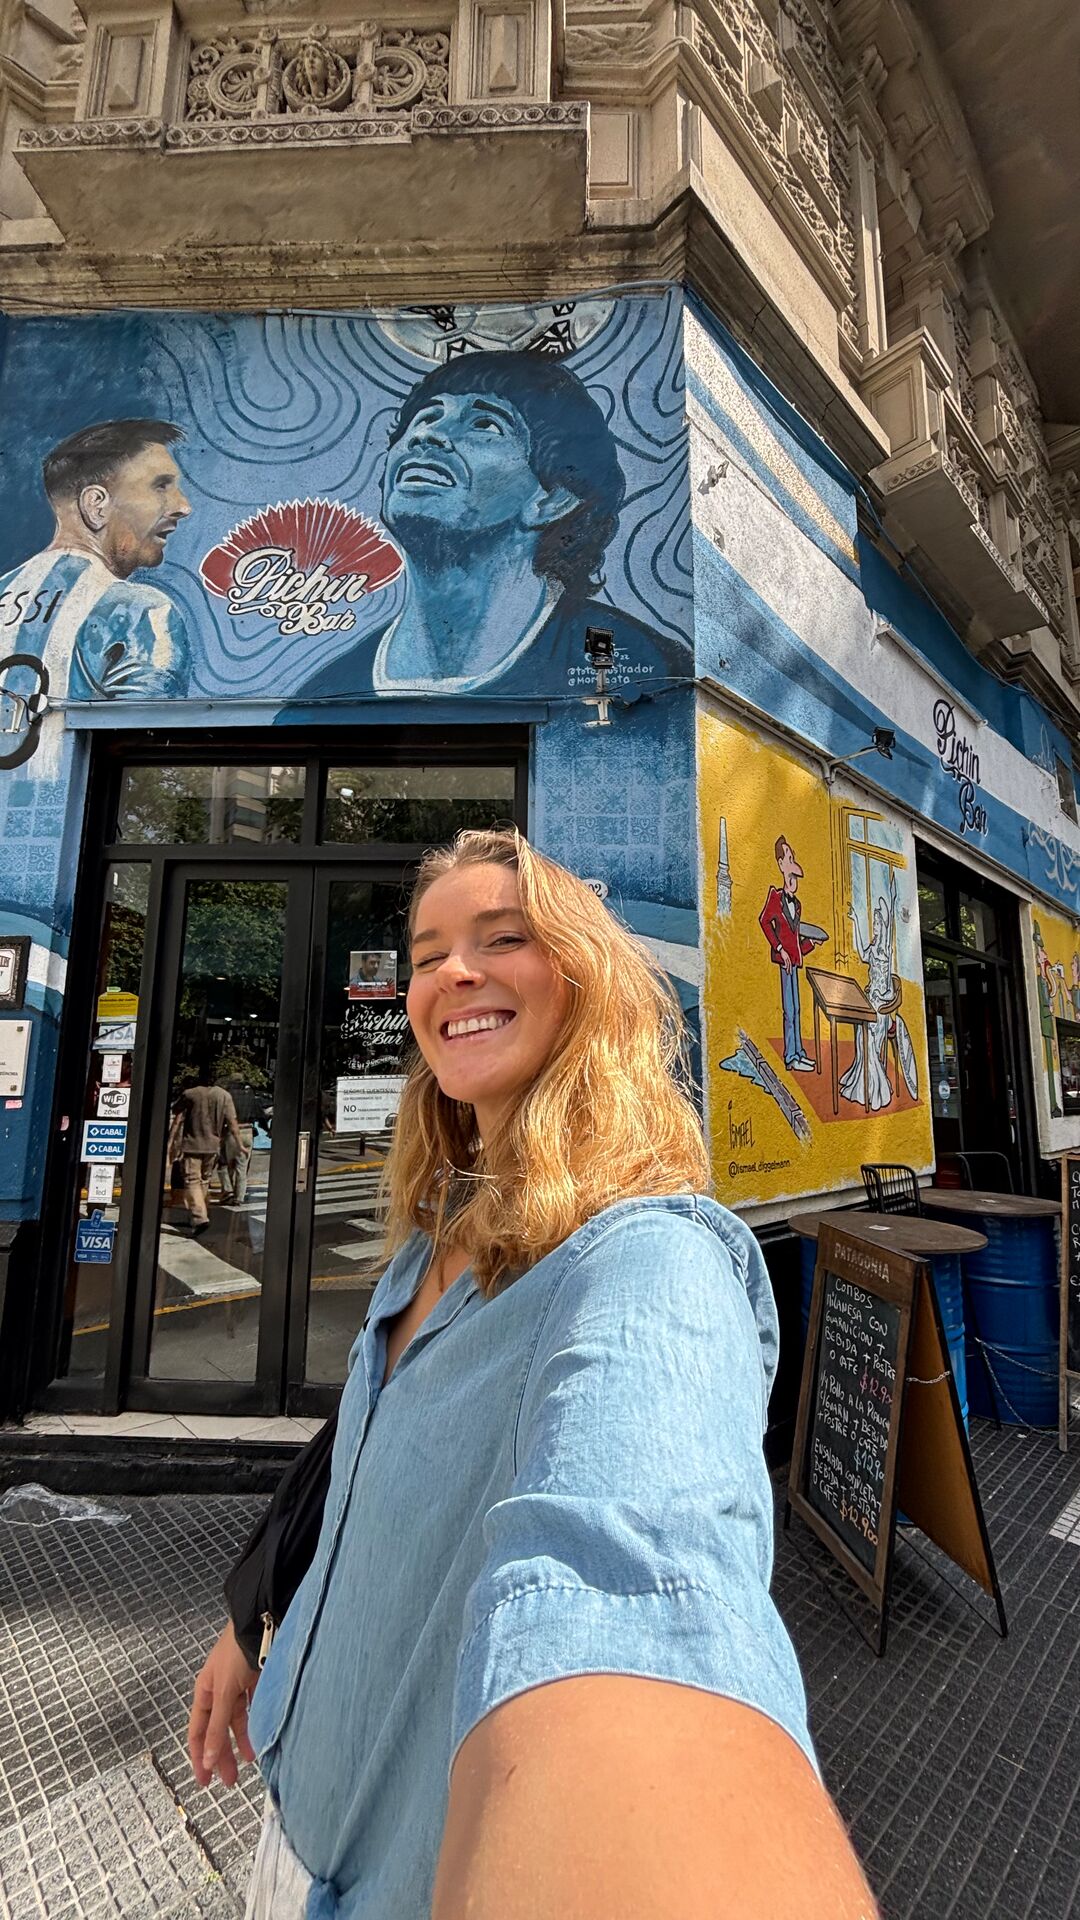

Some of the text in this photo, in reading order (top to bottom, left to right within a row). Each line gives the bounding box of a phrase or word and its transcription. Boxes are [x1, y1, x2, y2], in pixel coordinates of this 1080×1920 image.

[227, 546, 369, 604] Pichin
[279, 601, 357, 636] Bar
[933, 699, 981, 784] Pichin
[371, 1030, 403, 1046] Bar
[343, 1105, 357, 1113] NO
[100, 1128, 123, 1136] CABAL
[98, 1145, 122, 1153] CABAL
[80, 1236, 111, 1249] VISA
[834, 1242, 890, 1283] PATAGONIA
[869, 1315, 888, 1337] CON
